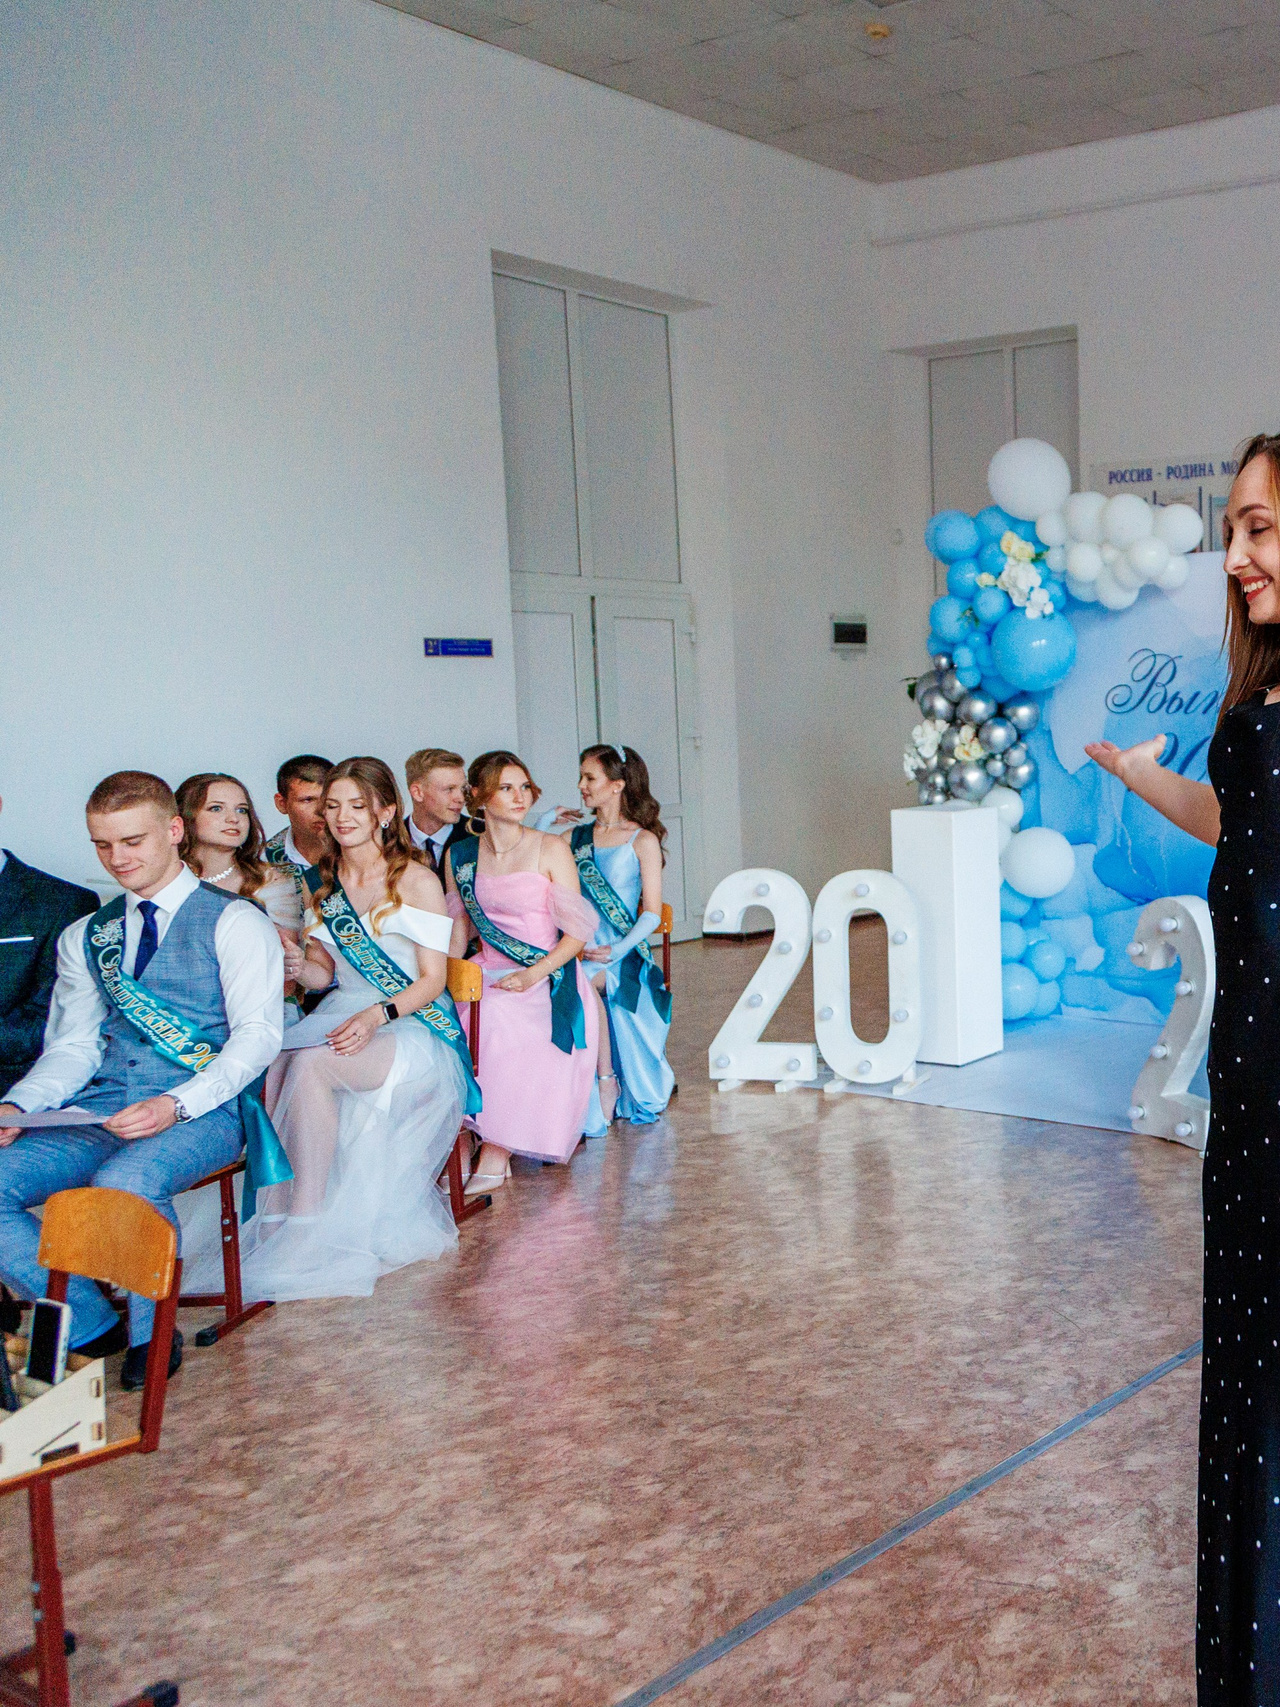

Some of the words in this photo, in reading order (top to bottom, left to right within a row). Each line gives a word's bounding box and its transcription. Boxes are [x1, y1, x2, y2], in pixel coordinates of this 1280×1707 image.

[1108, 467, 1153, 484] РОССИЯ
[1166, 462, 1215, 480] РОДИНА
[1221, 460, 1239, 475] МО
[331, 915, 402, 995] Выпускн
[98, 945, 193, 1053] Выпускник
[178, 1042, 219, 1073] 20
[1131, 895, 1216, 1152] 2
